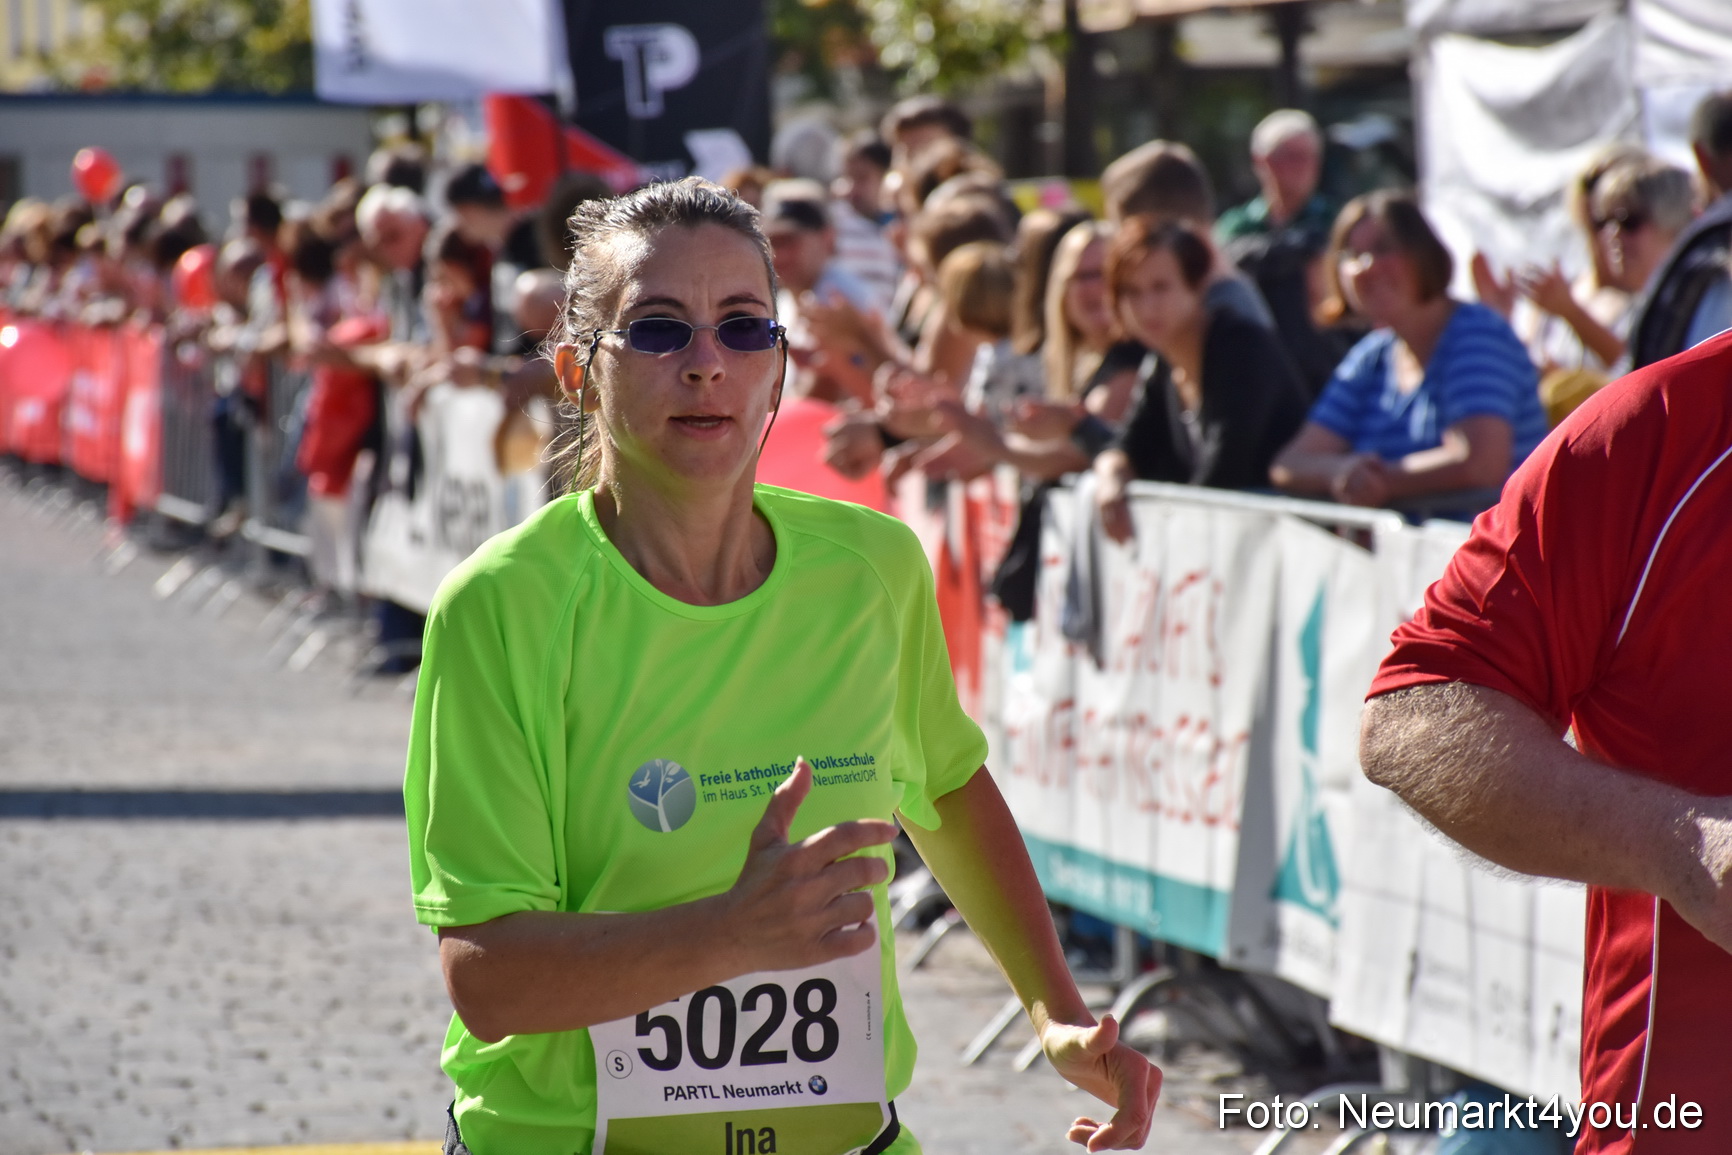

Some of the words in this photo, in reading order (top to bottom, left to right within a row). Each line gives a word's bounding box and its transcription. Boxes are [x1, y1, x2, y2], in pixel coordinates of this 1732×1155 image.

[699, 770, 732, 787] Freie
[734, 760, 798, 783] katholisc
[810, 752, 876, 770] Volksschule
[702, 790, 717, 803] im
[720, 787, 748, 801] Haus
[750, 784, 766, 797] St.
[635, 978, 840, 1071] 5028
[614, 1056, 625, 1072] S
[664, 1085, 720, 1101] PARTL
[723, 1080, 803, 1099] Neumarkt
[725, 1121, 777, 1155] Ina
